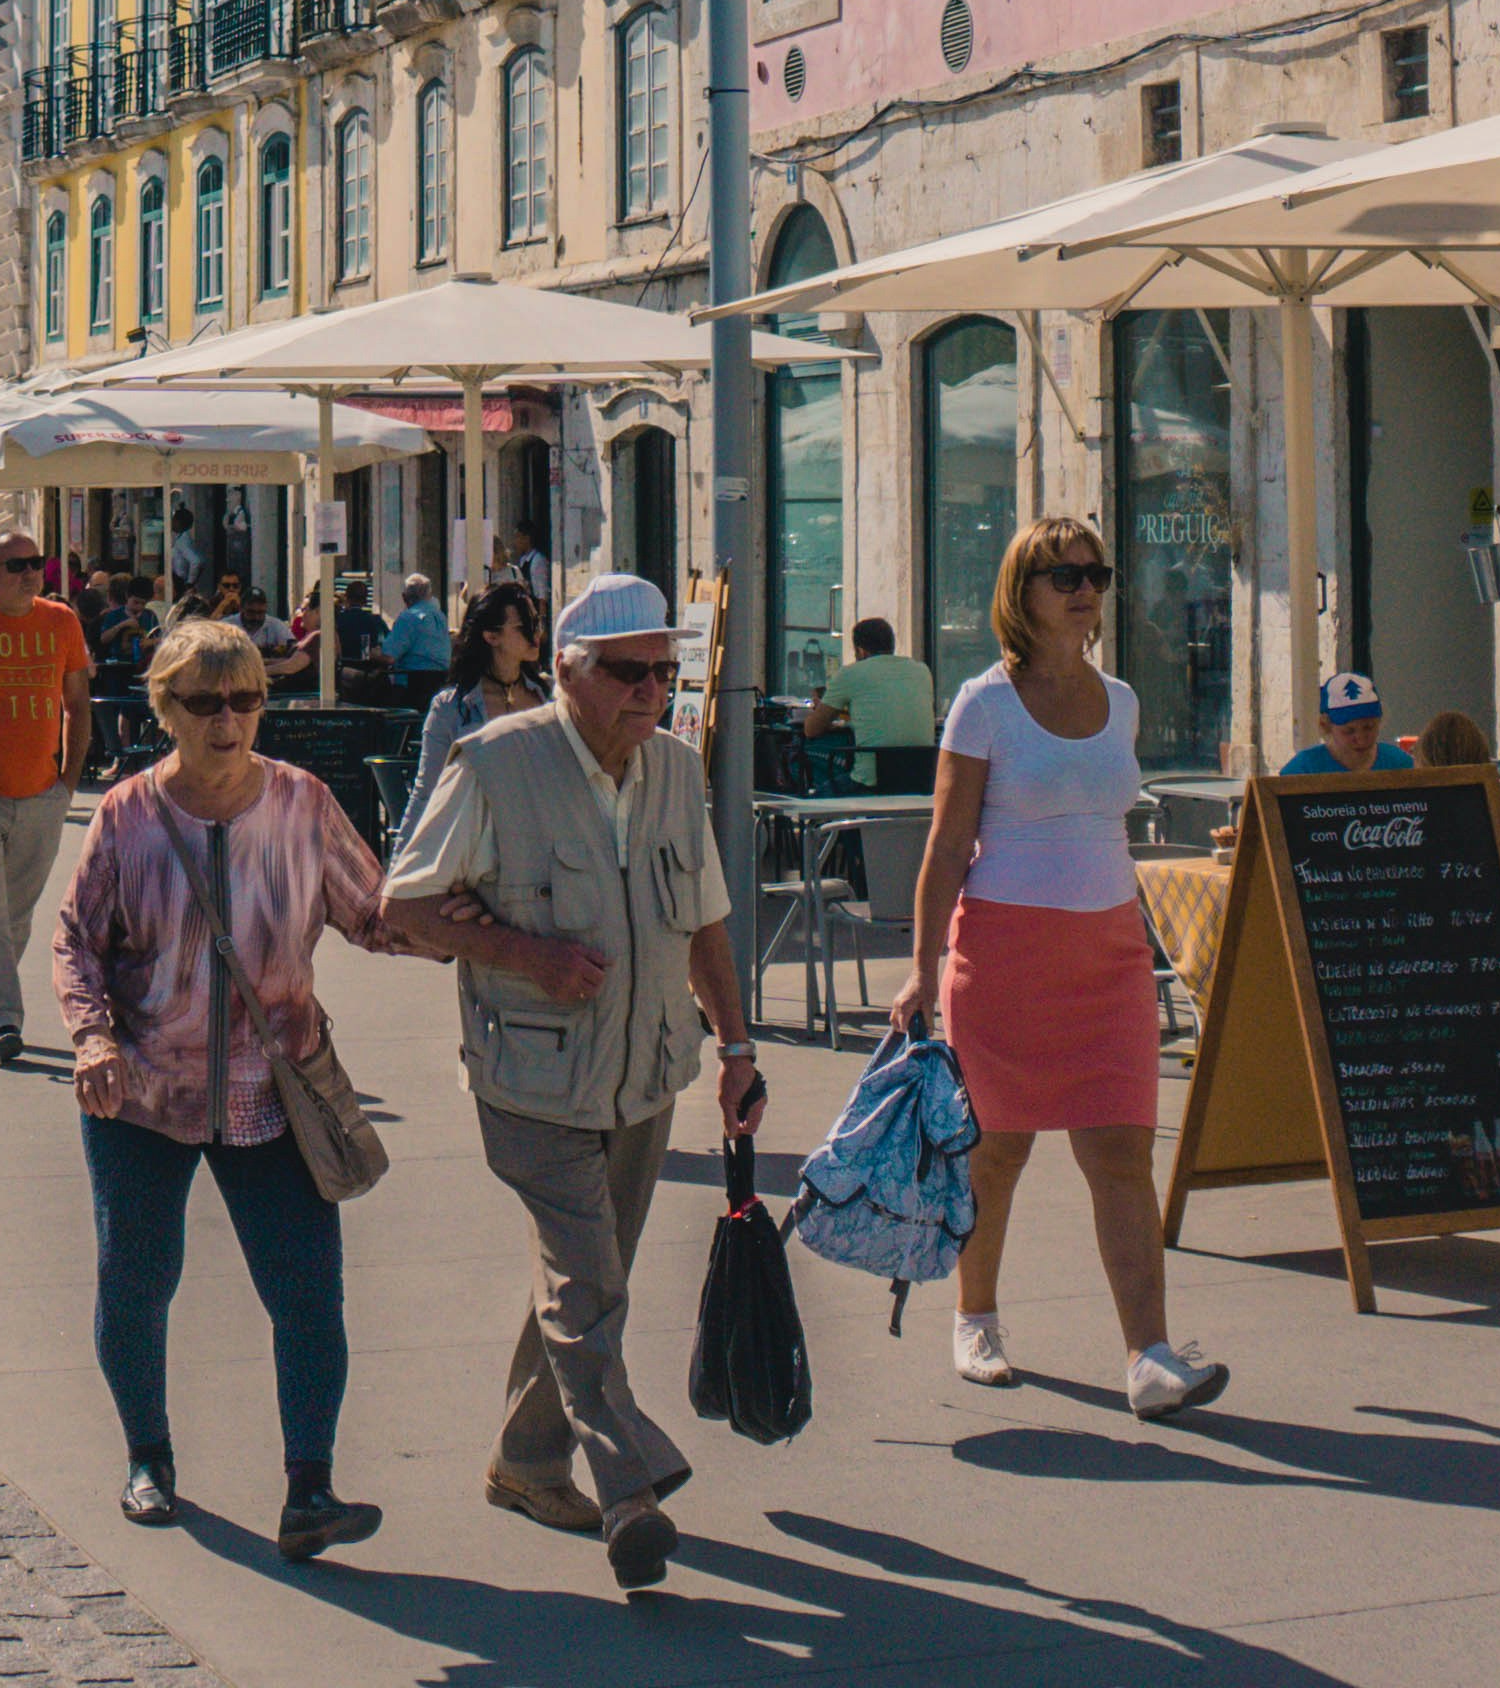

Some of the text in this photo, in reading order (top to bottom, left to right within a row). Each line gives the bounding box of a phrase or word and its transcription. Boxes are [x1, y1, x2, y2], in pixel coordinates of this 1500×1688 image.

[54, 430, 158, 444] SUPER BOCK
[1303, 801, 1428, 818] Saboreia o teu menu
[1311, 816, 1425, 851] com Coca-Cola
